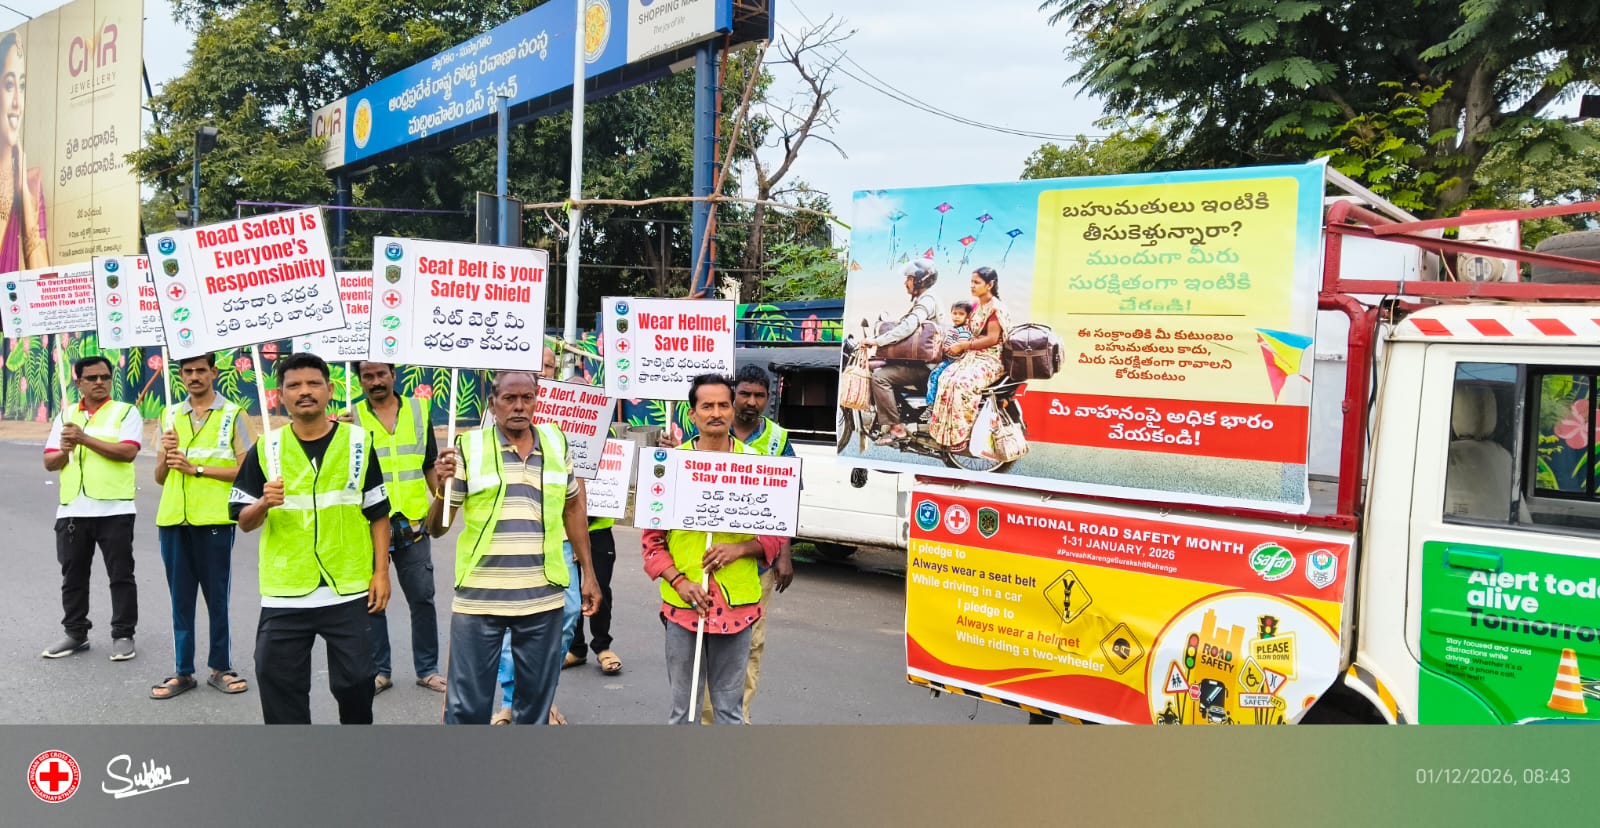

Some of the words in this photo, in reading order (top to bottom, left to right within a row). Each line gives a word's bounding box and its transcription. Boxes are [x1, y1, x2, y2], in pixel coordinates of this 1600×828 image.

[638, 0, 680, 24] SHOPPING
[69, 24, 118, 77] CMR
[70, 72, 116, 94] JEWELLERY
[466, 88, 484, 114] బస్
[316, 108, 342, 137] CMR
[66, 138, 79, 160] ప్రతి
[60, 166, 72, 186] ప్రతి
[1062, 198, 1195, 218] బహుమతులు
[1200, 192, 1270, 214] ఇంటికి
[196, 225, 239, 248] Road
[242, 216, 296, 241] Safety
[299, 212, 316, 230] is
[1082, 220, 1242, 247] తీసుకెళ్తున్నారా?
[214, 238, 308, 269] Everyone's
[1086, 248, 1181, 266] ముందుగా
[1187, 245, 1239, 264] మీరు
[205, 258, 326, 294] Responsibility
[419, 256, 453, 275] Seat
[458, 260, 488, 278] Belt
[493, 262, 506, 279] is
[510, 266, 544, 283] your
[48, 277, 88, 286] Overtaking
[431, 280, 480, 302] Safety
[485, 282, 530, 303] Shield
[1068, 273, 1178, 295] సురక్షితంగా
[1183, 272, 1251, 292] ఇంటికి
[30, 300, 57, 308] Smooth
[222, 290, 276, 313] రహదారి
[281, 284, 319, 305] భద్రత
[346, 304, 369, 314] Take
[215, 318, 241, 336] ప్రతి
[244, 312, 284, 330] ఒక్కరి
[287, 300, 334, 321] బాధ్యత
[432, 306, 463, 325] సీట్
[469, 311, 498, 334] బెల్ట్
[504, 312, 524, 329] మీ
[638, 313, 674, 330] Wear
[678, 314, 730, 333] Helmet,
[424, 332, 474, 351] భద్రతా
[480, 334, 530, 351] కవచం
[655, 334, 689, 351] Save
[693, 335, 714, 352] life
[1077, 329, 1091, 338] ఈ
[1094, 328, 1153, 341] సంక్రాంతికి
[1156, 328, 1171, 340] మీ
[1174, 331, 1233, 341] కుటుంబం
[1095, 342, 1174, 354] బహుమతులు
[1177, 344, 1212, 356] కాదు,
[641, 357, 675, 372] హెల్మెట్
[1078, 353, 1106, 365] మీరు
[1109, 355, 1176, 368] సురక్షితంగా
[1178, 357, 1232, 369] రావాలని
[549, 387, 576, 403] Alert,
[579, 392, 608, 407] Avoid
[535, 401, 598, 420] Distractions
[1049, 398, 1070, 416] మీ
[1074, 401, 1162, 428] వాహనంపై
[1166, 408, 1215, 427] అధిక
[1220, 413, 1274, 430] భారం
[560, 420, 597, 436] Driving
[1108, 424, 1201, 446] వేయకండి!
[685, 460, 712, 472] Stop
[715, 462, 726, 472] at
[731, 463, 752, 473] Red
[692, 472, 720, 484] Stay
[722, 476, 736, 484] on
[741, 475, 759, 486] the
[763, 477, 787, 487] Line
[702, 490, 724, 500] రెడ్
[728, 492, 768, 506] సిగ్నల్
[696, 503, 720, 517] వద్ద
[729, 519, 787, 532] ఉండండి
[1007, 513, 1075, 532] NATIONAL
[1079, 523, 1118, 538] ROAD
[1123, 528, 1182, 546] SAFETY
[1186, 536, 1244, 555] MONTH
[919, 544, 953, 559] pledge
[956, 549, 966, 559] to
[1062, 536, 1083, 548] 1-31
[1086, 539, 1146, 557] JANUARY,
[1148, 547, 1175, 560] 2026
[1254, 548, 1291, 575] safar
[912, 558, 949, 574] Always
[951, 566, 976, 577] wear
[988, 571, 1011, 584] seat
[1015, 575, 1036, 588] belt
[1467, 568, 1539, 592] Alert
[912, 574, 940, 588] While
[943, 580, 979, 596] driving
[982, 585, 992, 596] in
[1004, 592, 1022, 602] car
[957, 599, 961, 609] I
[964, 600, 1000, 619] pledge
[1003, 608, 1014, 619] to
[1466, 587, 1539, 614] alive
[956, 615, 994, 632] Always
[998, 625, 1024, 637] wear
[1027, 631, 1034, 640] a
[1037, 630, 1080, 648] helmet
[956, 630, 985, 647] While
[988, 638, 1019, 656] riding
[1023, 647, 1030, 656] a
[1033, 648, 1104, 672] two-wheeler
[1202, 643, 1232, 662] ROAD
[1256, 642, 1289, 654] PLEASE
[1446, 637, 1462, 646] Stay
[1464, 640, 1493, 650] focused
[1510, 647, 1532, 656] avoid
[1446, 646, 1488, 657] distractions
[1489, 652, 1508, 660] while
[1201, 655, 1234, 673] SAFETY
